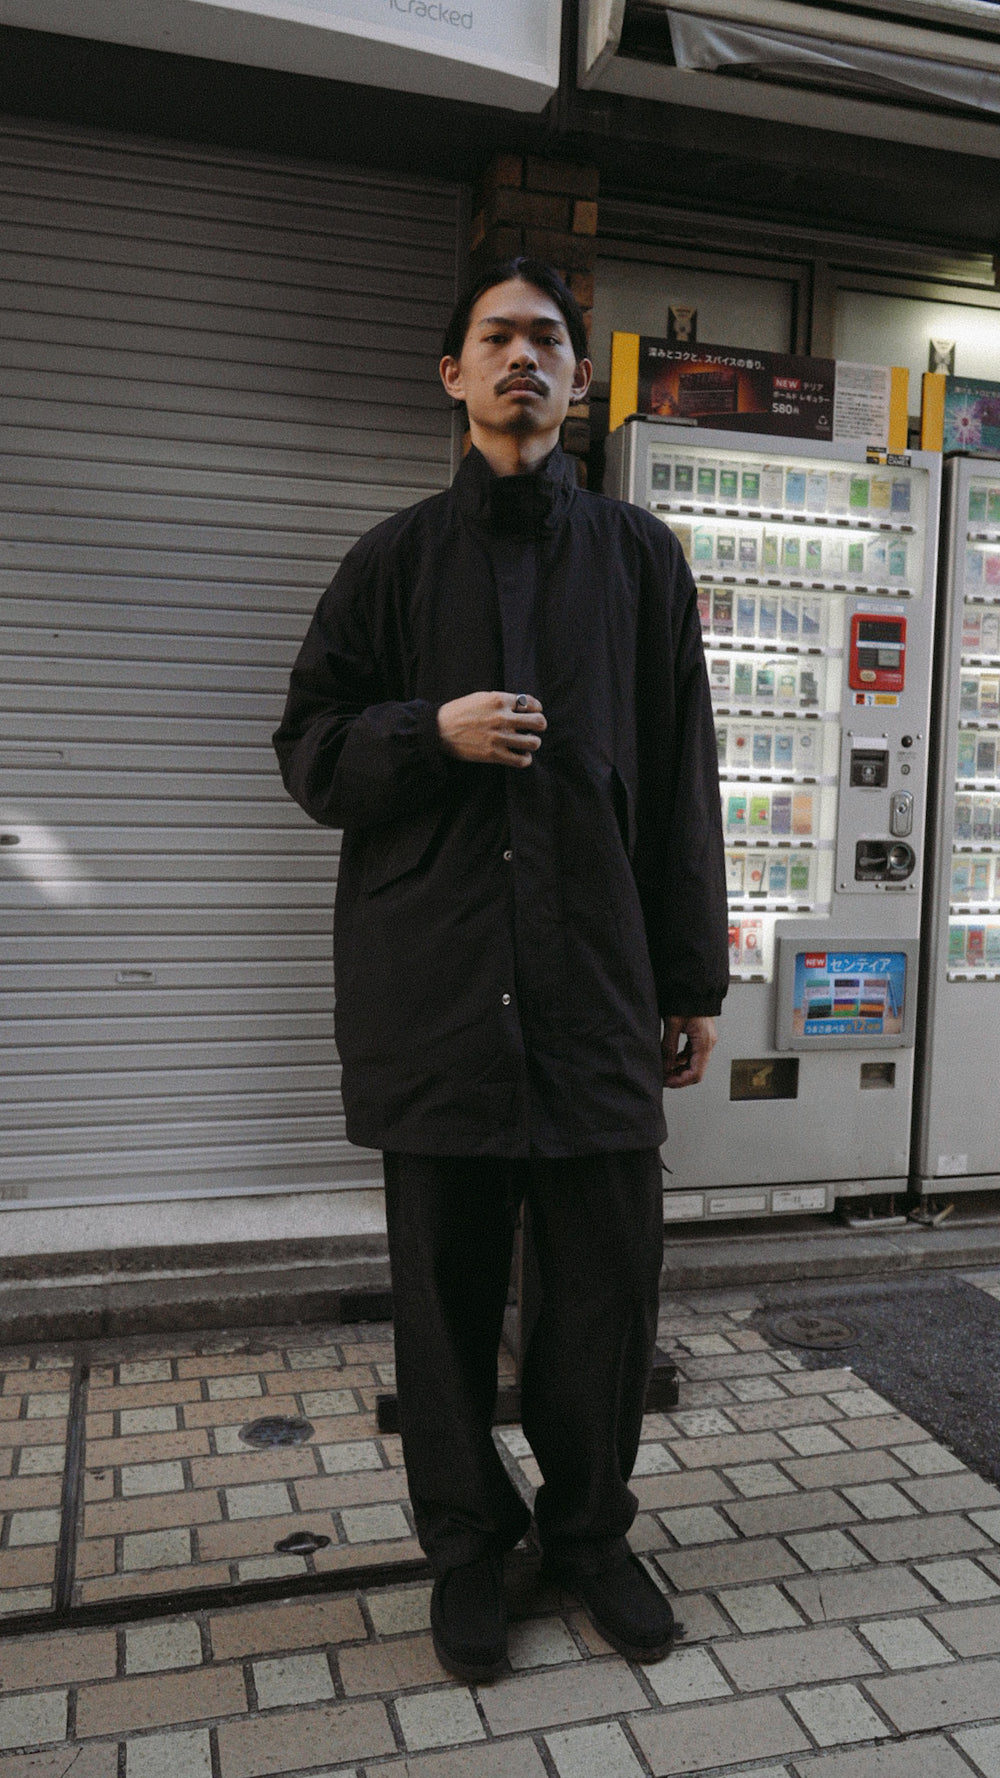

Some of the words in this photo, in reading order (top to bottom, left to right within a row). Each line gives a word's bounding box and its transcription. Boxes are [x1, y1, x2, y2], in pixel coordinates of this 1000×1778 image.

[775, 378, 798, 389] NEW
[805, 958, 826, 967] NEW
[831, 958, 892, 972] センティア
